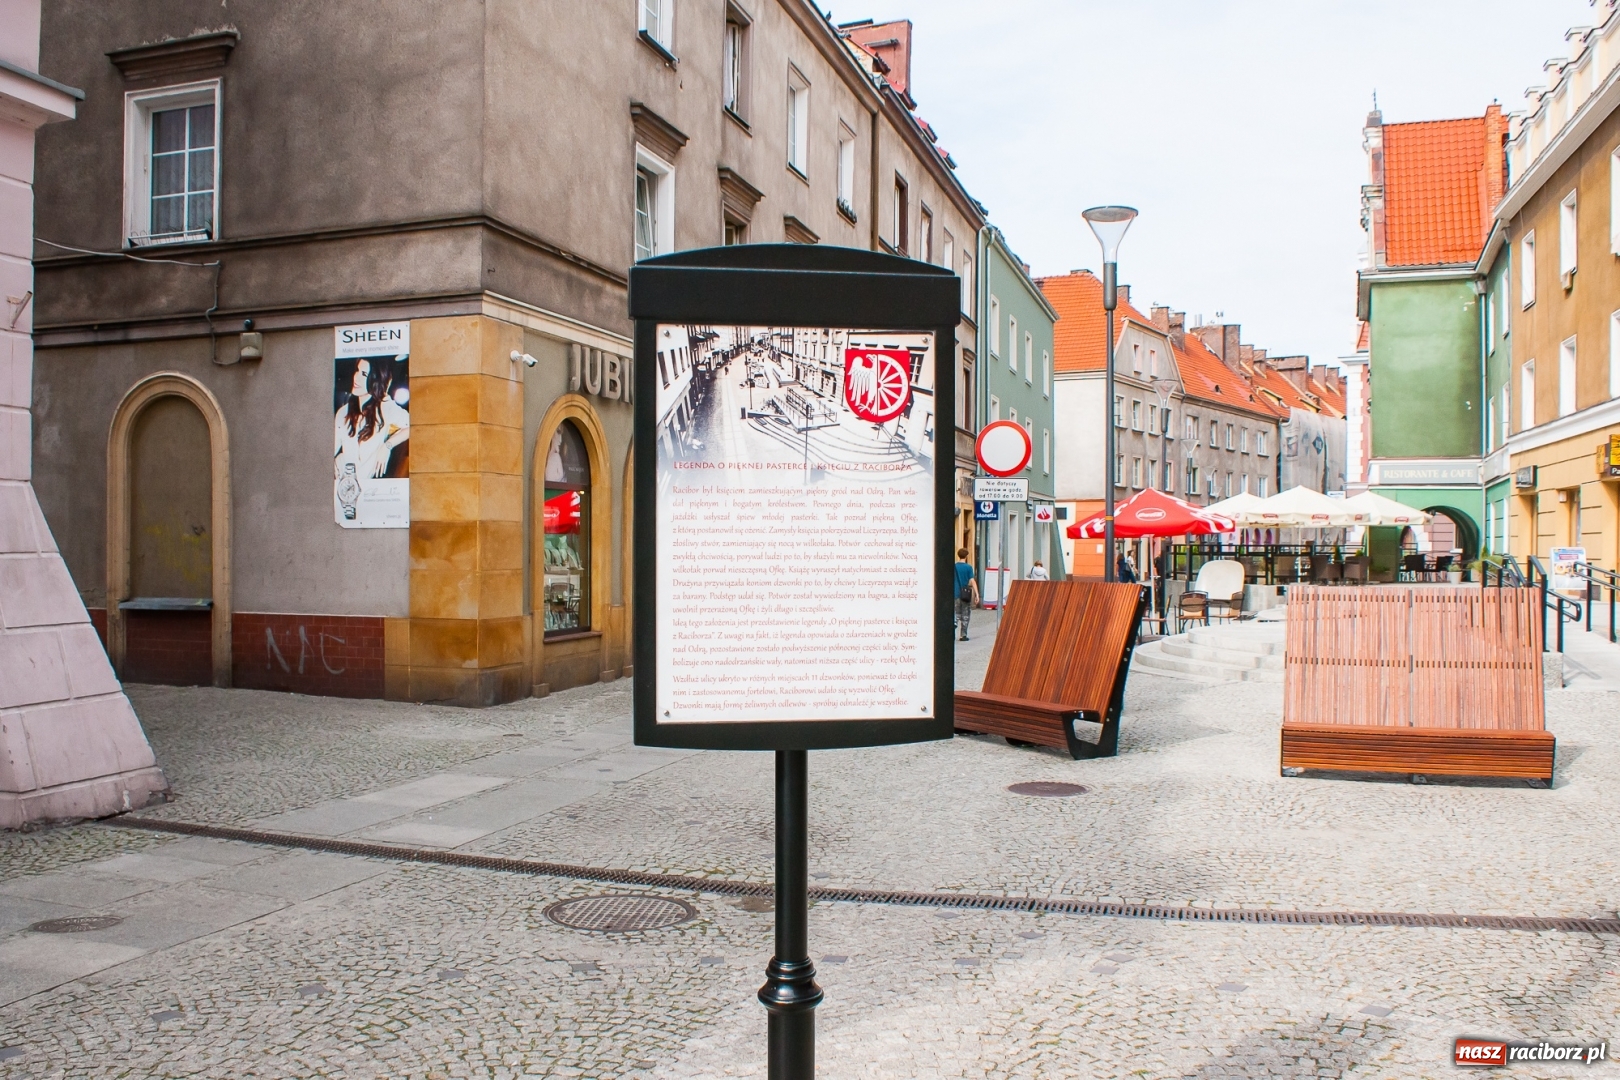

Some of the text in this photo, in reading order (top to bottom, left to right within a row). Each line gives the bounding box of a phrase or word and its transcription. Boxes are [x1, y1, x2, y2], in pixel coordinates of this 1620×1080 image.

[342, 329, 401, 344] SHEEN
[674, 462, 715, 470] LEGENDA
[718, 462, 725, 470] O
[728, 462, 763, 471] PIĘKNEJ
[766, 462, 807, 470] PASTERCE
[817, 462, 851, 472] KSIĘCIU
[853, 462, 859, 470] Z
[862, 463, 912, 471] RACIBORZA
[1383, 469, 1473, 478] RISTORANTE & CAFE
[672, 485, 699, 494] Racibor
[850, 486, 864, 495] nad
[888, 487, 901, 495] Pan
[732, 499, 762, 510] bogatym
[812, 499, 842, 510] Pewnego
[869, 500, 896, 510] podczas
[826, 512, 838, 521] Tak
[764, 552, 782, 560] ludzi
[746, 578, 772, 586] koniom
[774, 578, 802, 586] dzwonki
[834, 577, 856, 588] chciwy
[688, 618, 703, 629] tego
[735, 617, 749, 628] jest
[801, 617, 827, 628] legendy
[864, 616, 890, 627] pasterce
[724, 630, 744, 642] uwagi
[780, 630, 806, 641] legenda
[807, 630, 839, 641] opowiada
[894, 629, 918, 640] grodzie
[672, 644, 686, 653] nad
[672, 657, 699, 668] bolizuje
[784, 656, 818, 665] natomiast
[859, 655, 875, 666] ulicy
[700, 674, 717, 685] ulicy
[718, 674, 741, 685] ukryto
[778, 673, 810, 684] miejscach
[812, 672, 818, 681] 11
[672, 688, 686, 696] nim
[673, 700, 703, 709] Dzwonki
